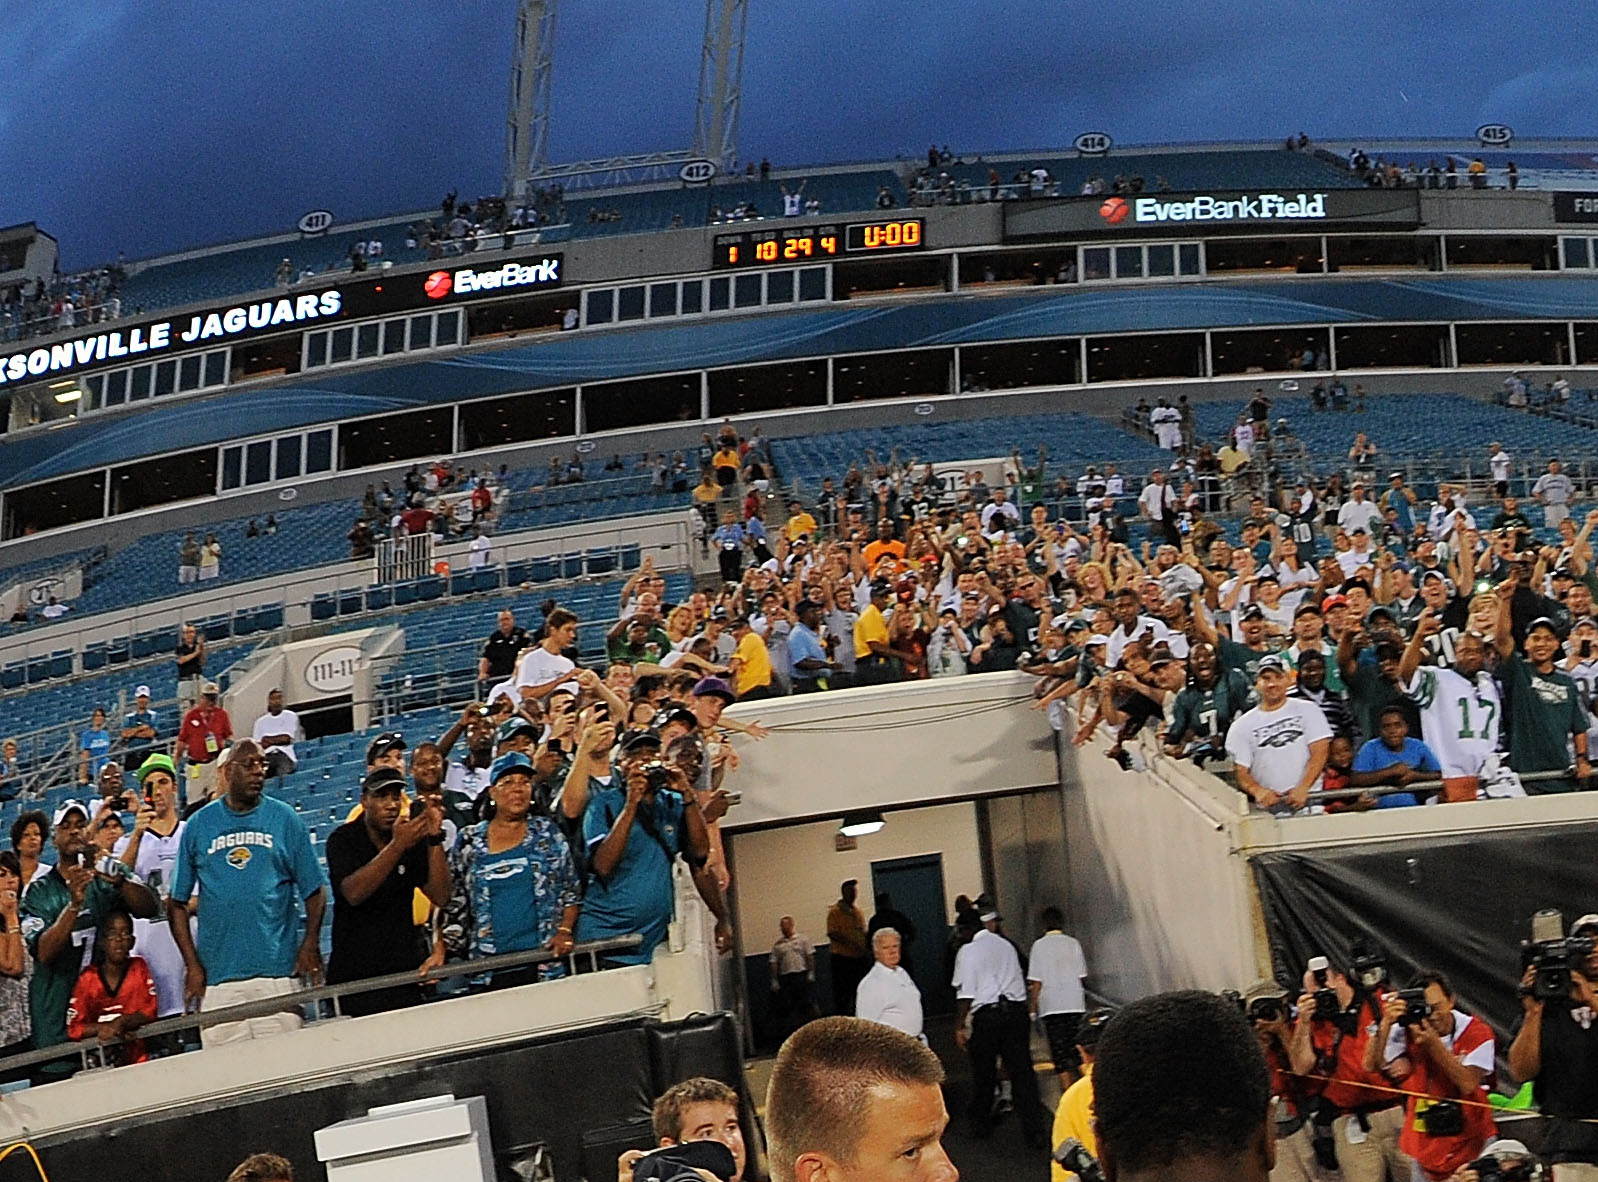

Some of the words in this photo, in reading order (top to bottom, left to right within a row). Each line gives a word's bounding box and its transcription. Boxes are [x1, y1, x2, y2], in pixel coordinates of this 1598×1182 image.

[686, 164, 711, 178] 412
[756, 241, 778, 260] 10
[784, 238, 813, 258] 29
[820, 237, 836, 253] 4
[453, 259, 559, 293] EverBank
[180, 290, 342, 342] JAGUARS
[313, 657, 363, 682] 111-11
[1457, 697, 1496, 740] 17
[207, 831, 273, 855] JAGUARS
